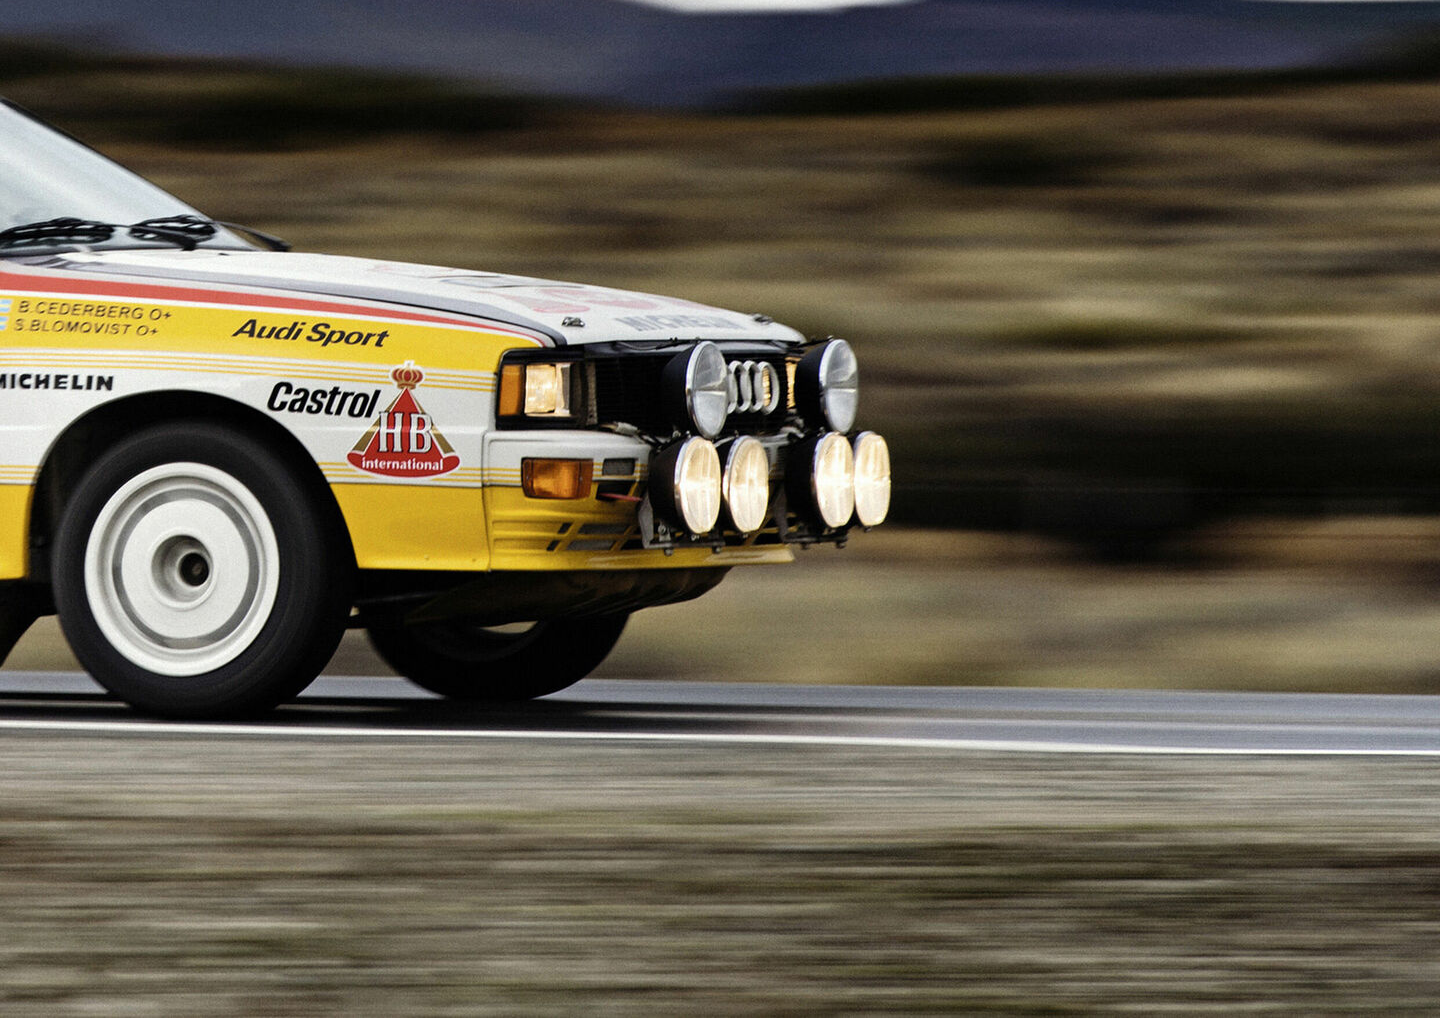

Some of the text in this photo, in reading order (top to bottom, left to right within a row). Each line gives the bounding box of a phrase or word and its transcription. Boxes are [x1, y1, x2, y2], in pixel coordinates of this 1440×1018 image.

[18, 299, 144, 320] B.CEDERBERG
[231, 318, 390, 348] Audi Sport
[266, 381, 381, 418] Castrol
[377, 410, 434, 454] HB
[360, 455, 445, 472] international
